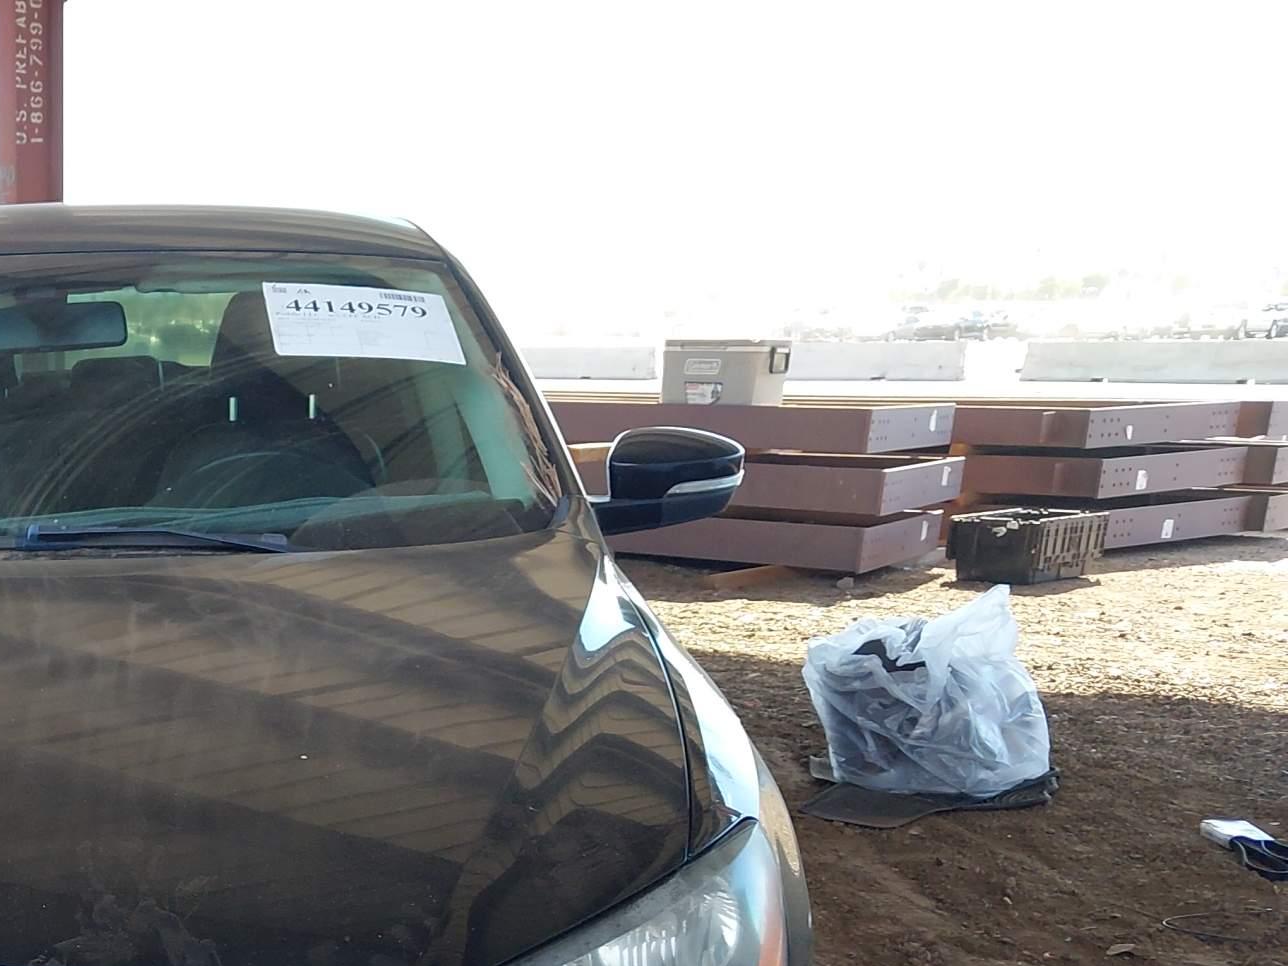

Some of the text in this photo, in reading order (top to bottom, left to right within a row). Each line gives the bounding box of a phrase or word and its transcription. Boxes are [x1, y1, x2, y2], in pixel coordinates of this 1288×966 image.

[15, 0, 28, 145] U.S. PREFAB
[285, 298, 428, 319] 44149579
